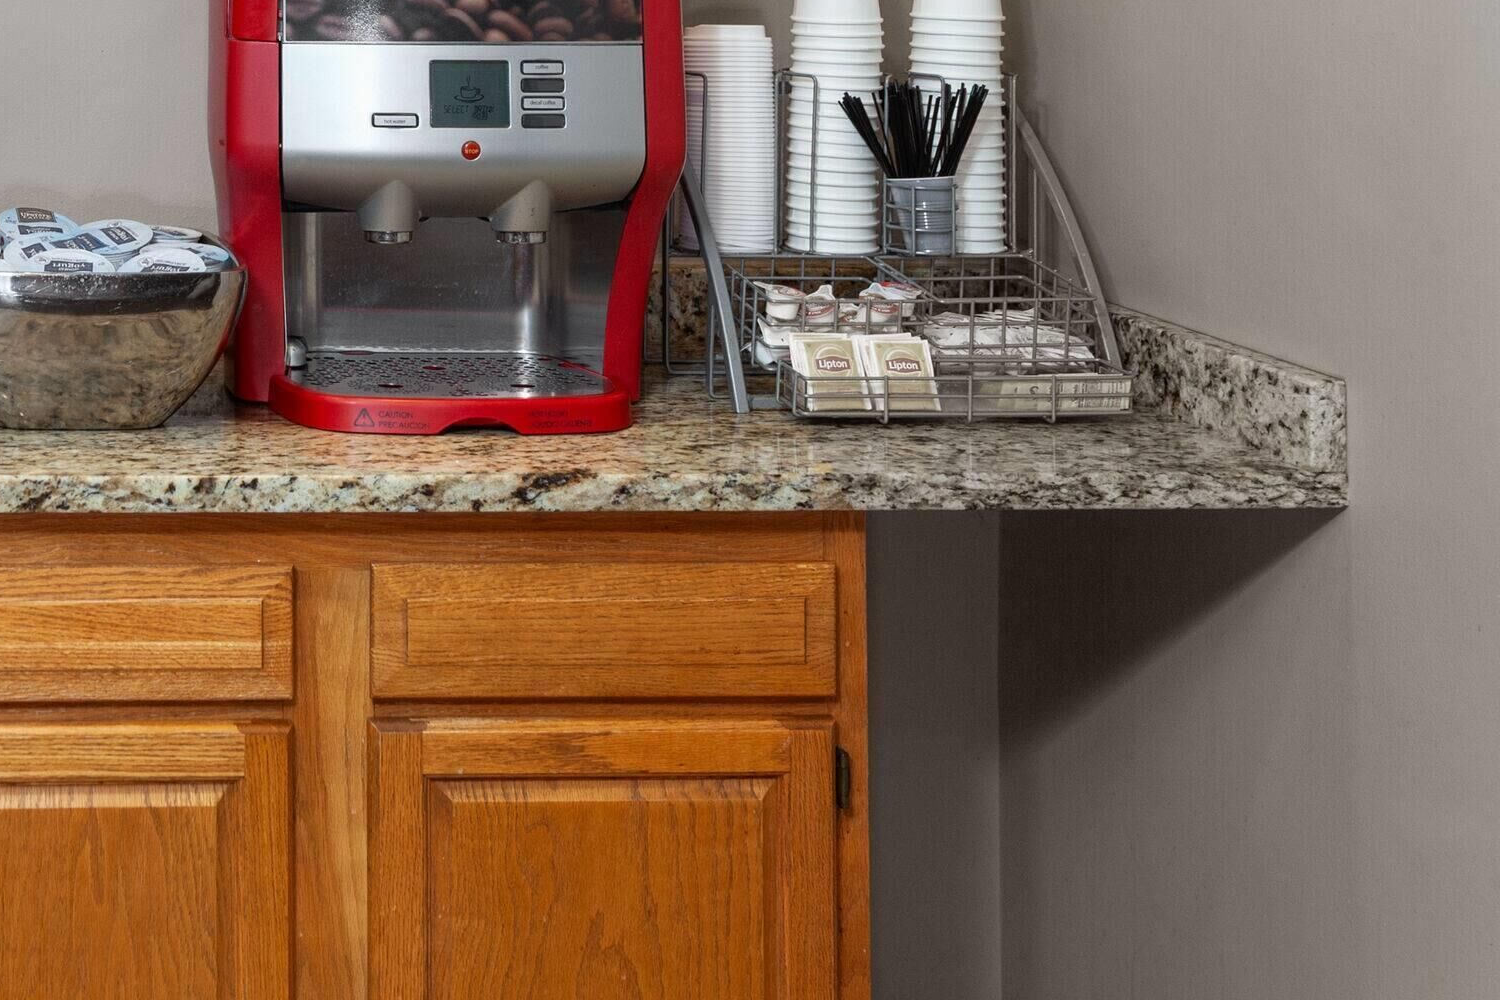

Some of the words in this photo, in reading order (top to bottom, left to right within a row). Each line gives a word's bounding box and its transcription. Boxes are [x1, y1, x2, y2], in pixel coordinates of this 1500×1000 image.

[443, 104, 469, 114] SELECT
[818, 358, 848, 369] Lipton
[888, 360, 919, 371] Lipton
[378, 410, 414, 419] CAUTION
